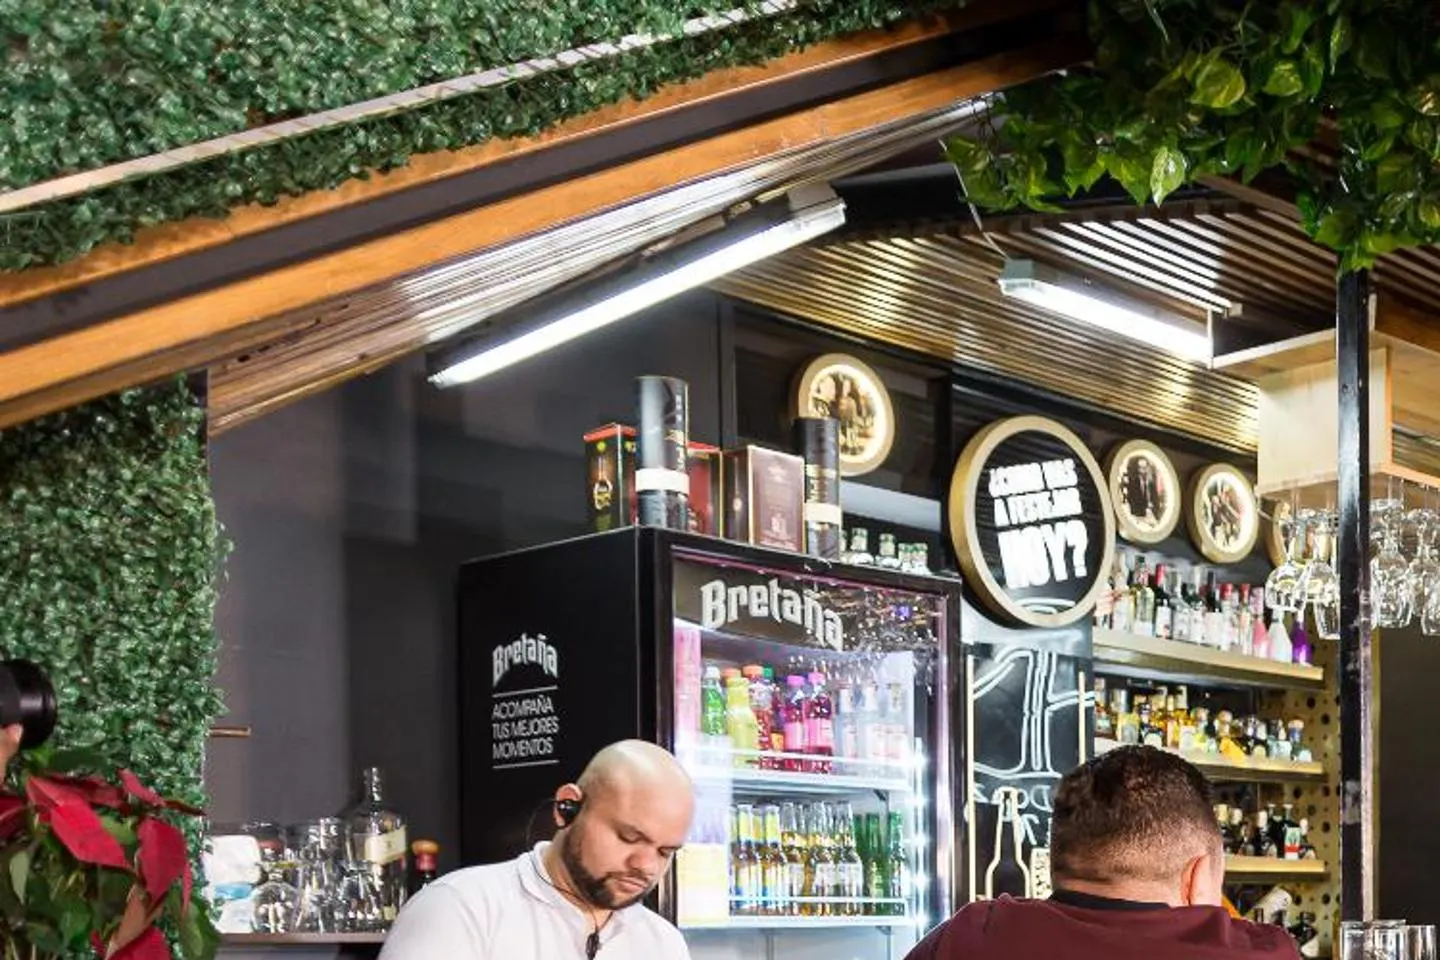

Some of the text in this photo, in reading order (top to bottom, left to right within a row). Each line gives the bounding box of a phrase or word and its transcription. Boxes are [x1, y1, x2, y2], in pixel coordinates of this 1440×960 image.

[998, 519, 1088, 589] HOY?
[700, 577, 843, 653] Bretaña
[492, 632, 558, 688] Bretaña
[492, 694, 555, 719] ACOMPAÑA
[492, 716, 560, 740] TUS MEJORES
[492, 736, 554, 760] MOMENTOS
